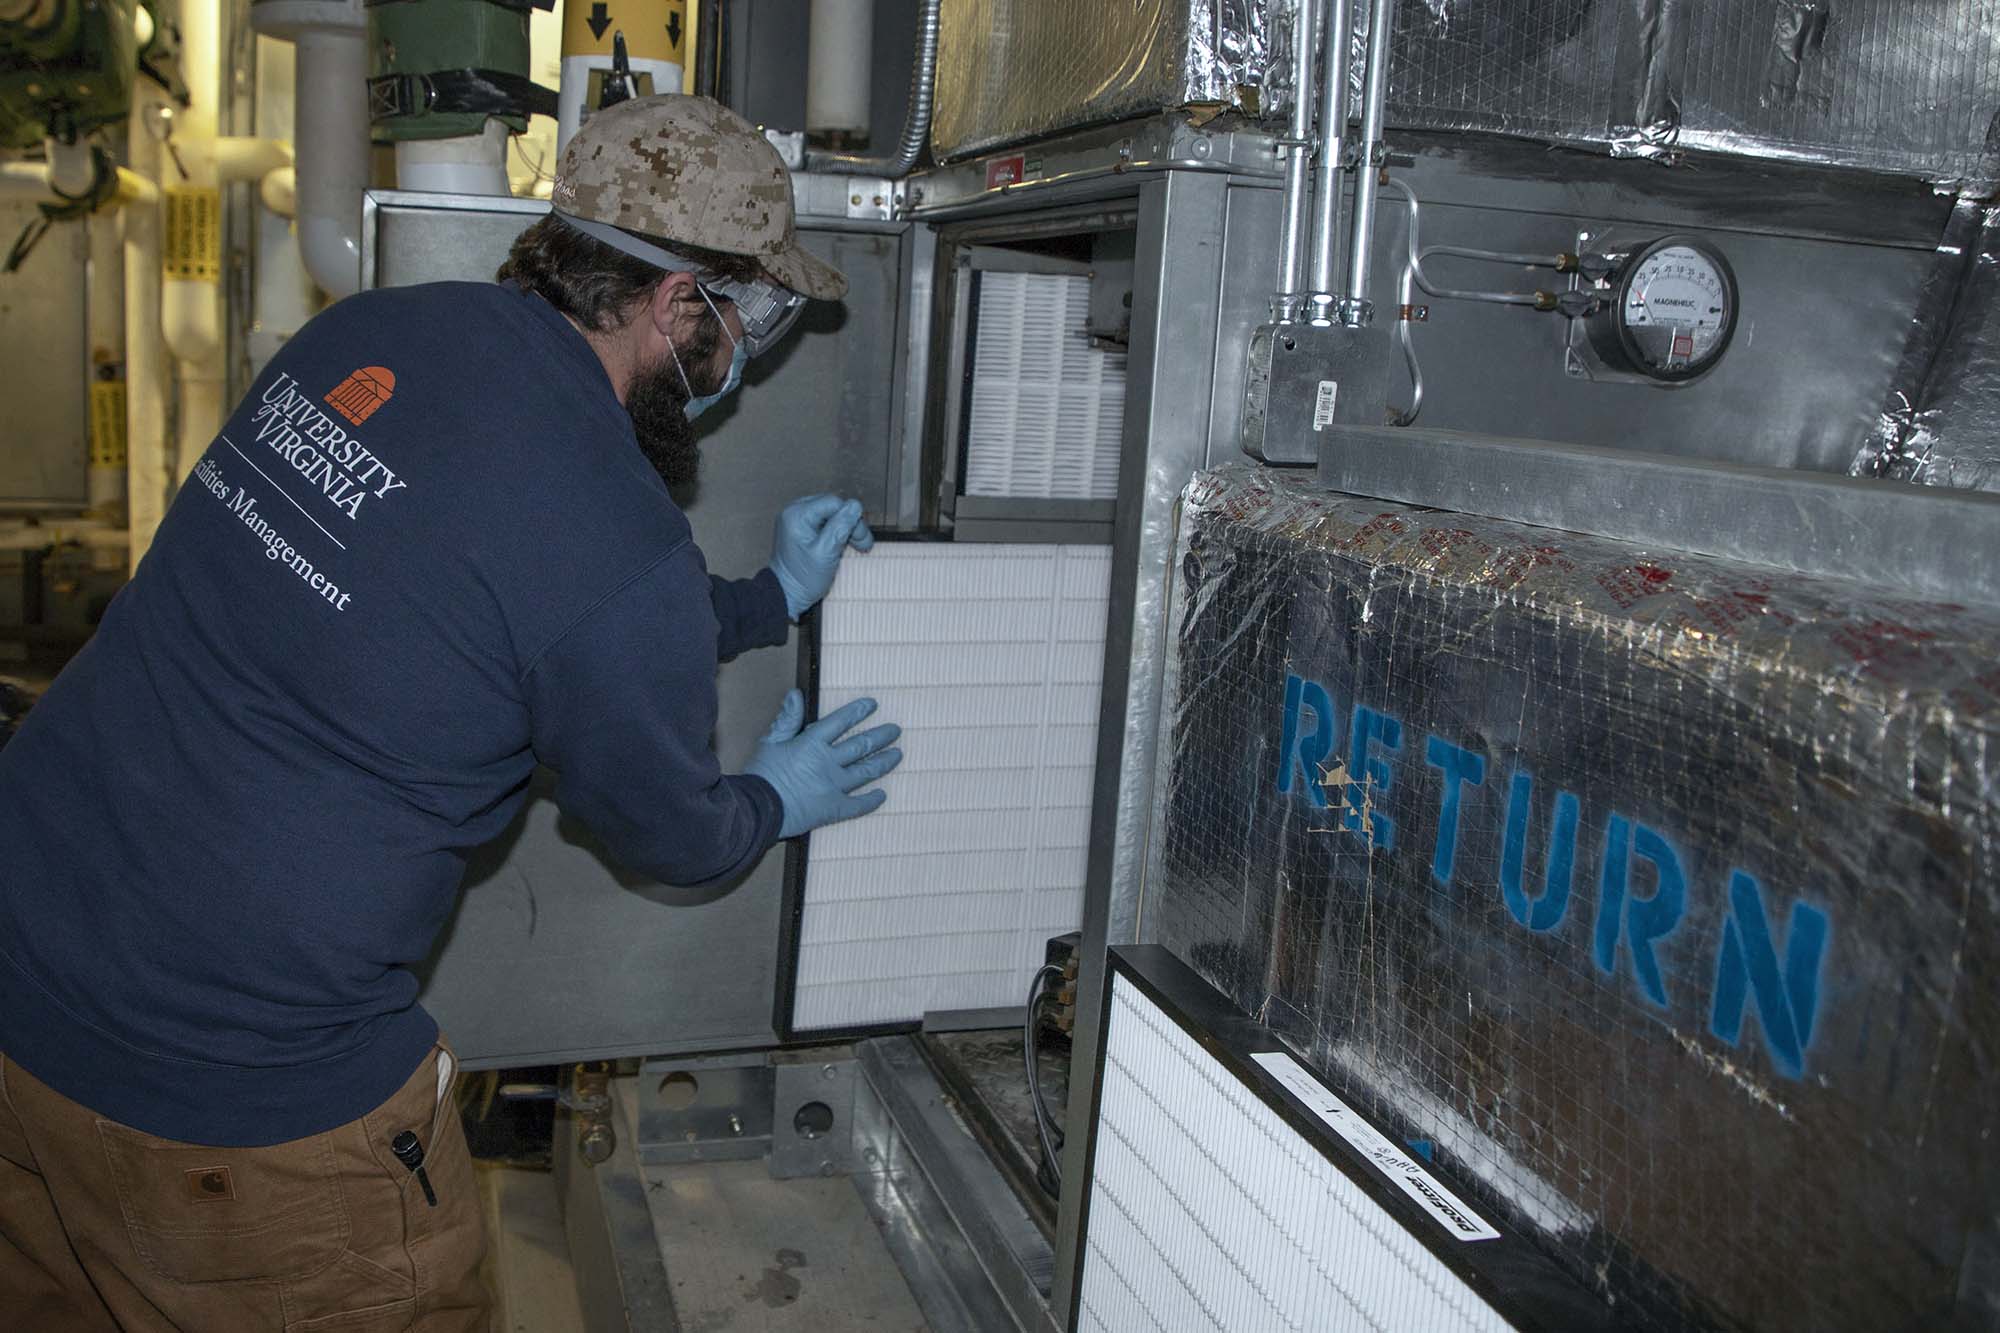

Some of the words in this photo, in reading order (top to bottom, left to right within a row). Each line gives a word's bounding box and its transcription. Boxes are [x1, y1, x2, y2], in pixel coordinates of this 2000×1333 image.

[256, 406, 367, 520] VIRGINIA
[263, 372, 407, 499] UNIVERSITY
[226, 487, 352, 611] Management
[1278, 673, 1830, 1079] RETURN
